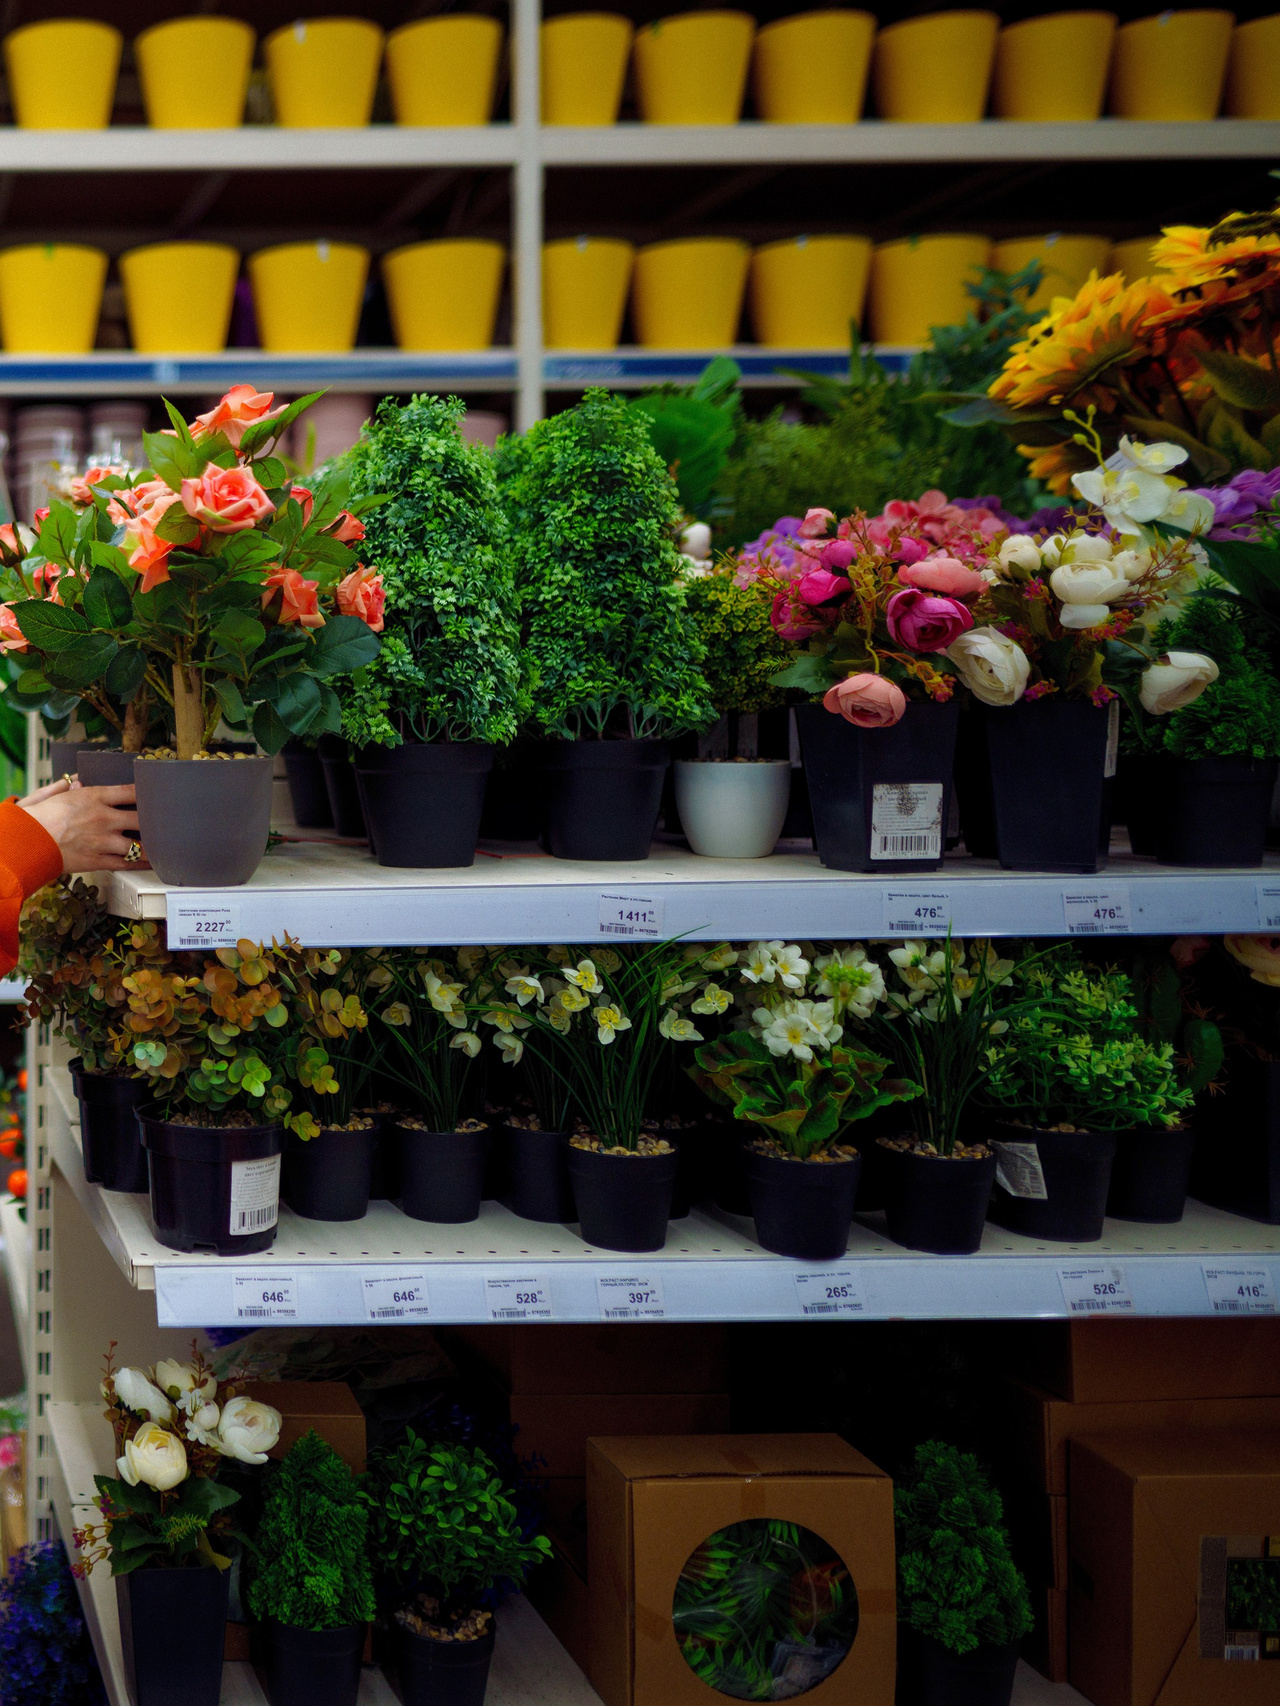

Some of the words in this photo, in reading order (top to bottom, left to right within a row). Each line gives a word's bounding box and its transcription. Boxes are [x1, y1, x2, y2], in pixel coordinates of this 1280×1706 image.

[915, 908, 936, 918] 476
[1094, 909, 1116, 919] 476
[826, 1287, 848, 1298] 265
[1094, 1284, 1116, 1294] 526
[1238, 1286, 1260, 1297] 416
[262, 1292, 284, 1302] 646
[394, 1291, 415, 1302] 646
[516, 1293, 537, 1303] 528
[629, 1293, 649, 1303] 397
